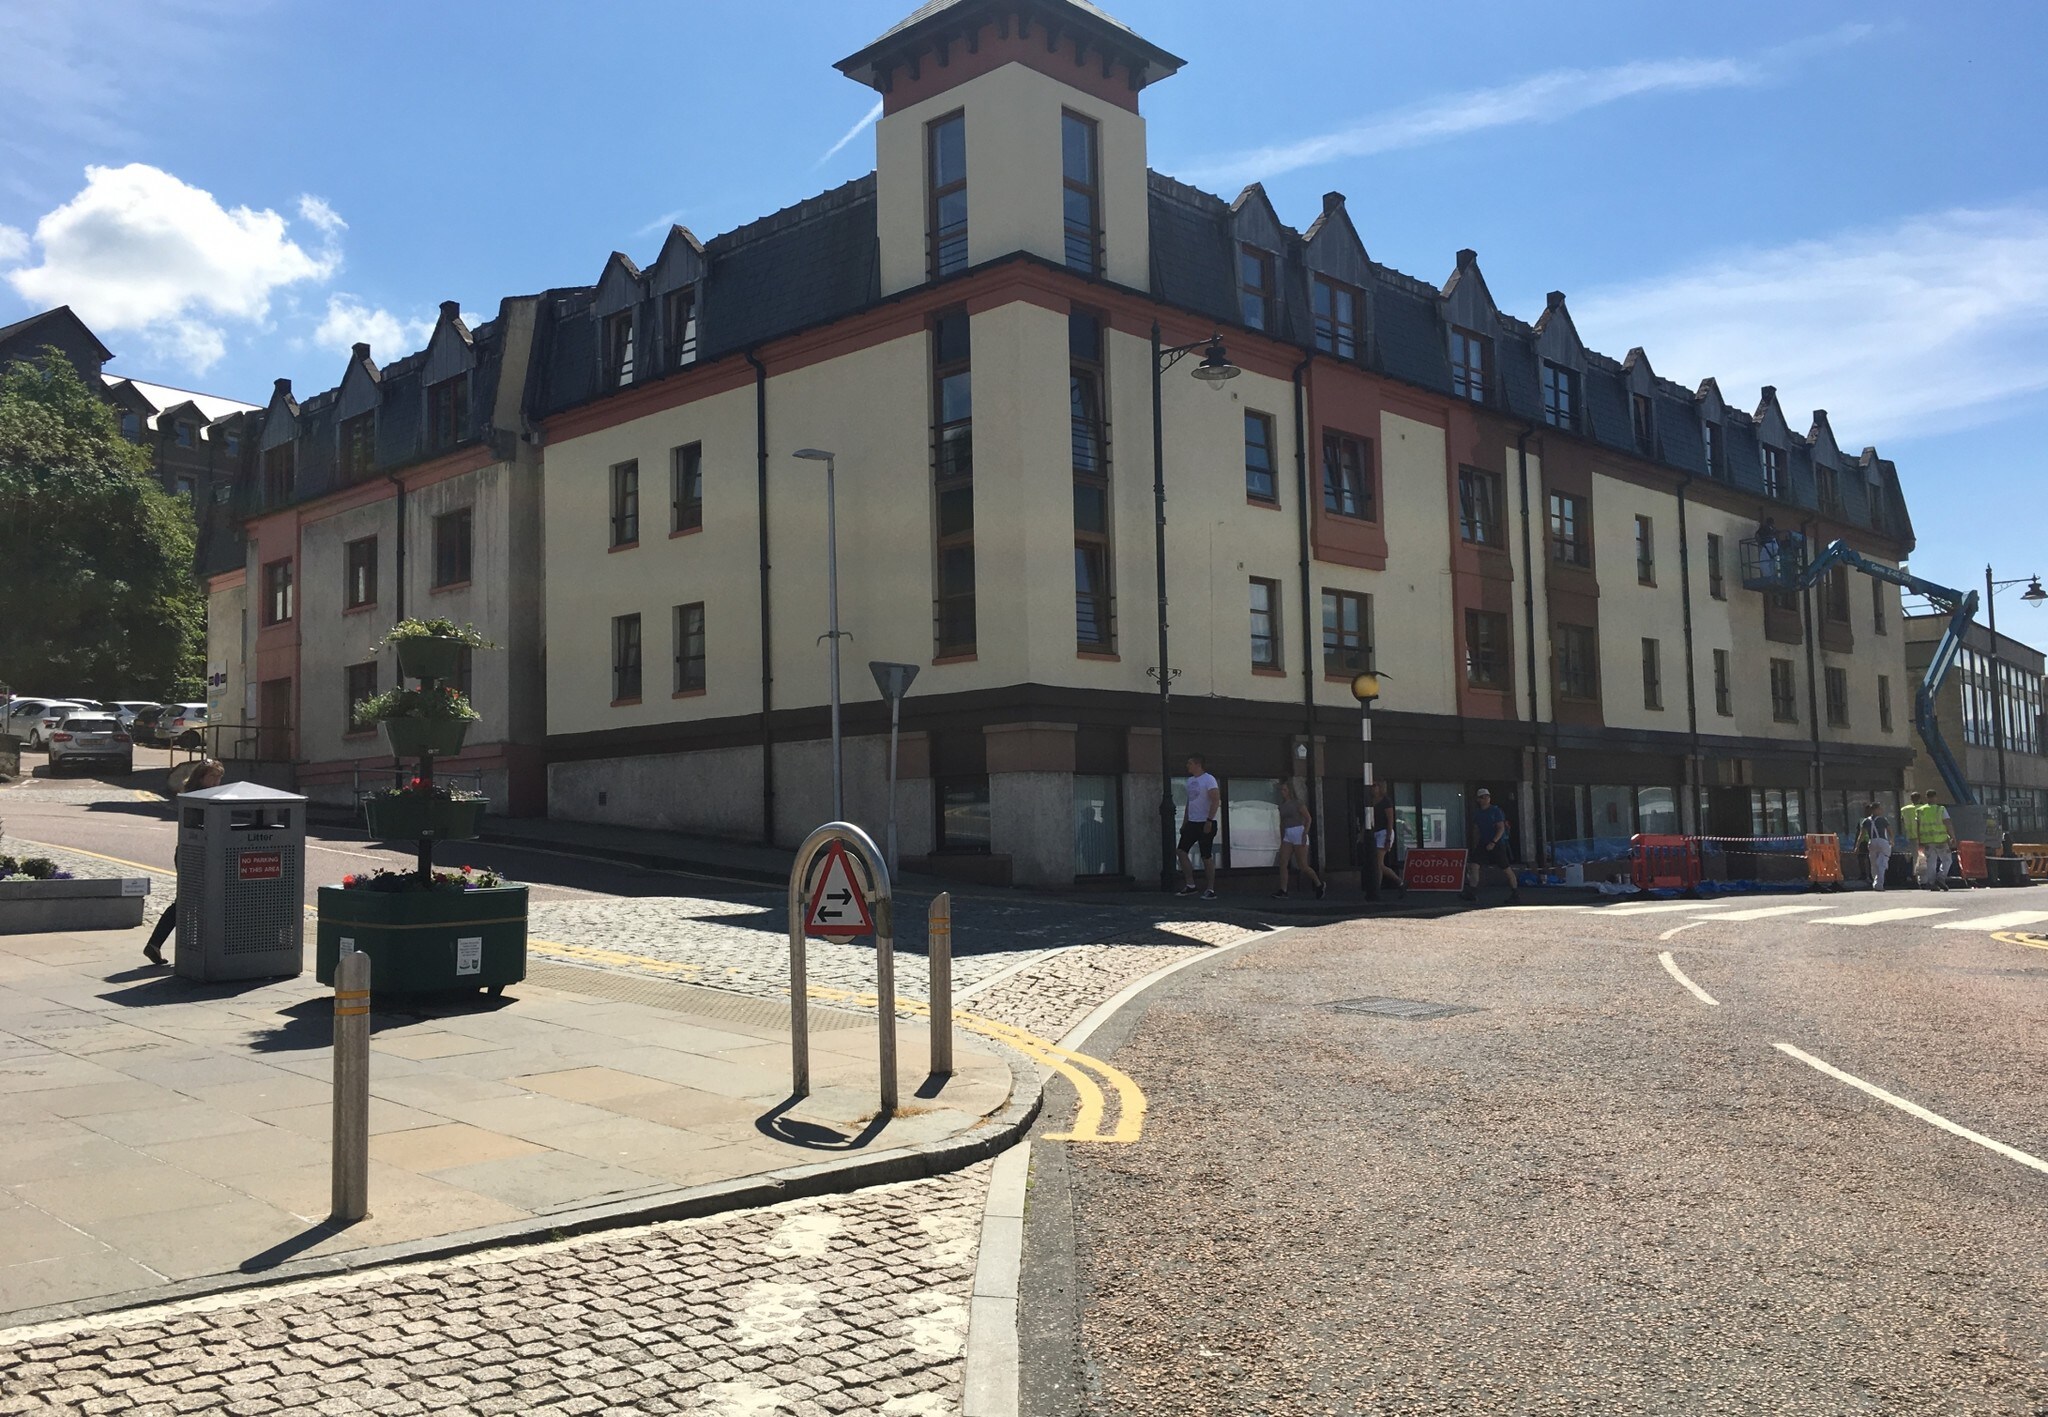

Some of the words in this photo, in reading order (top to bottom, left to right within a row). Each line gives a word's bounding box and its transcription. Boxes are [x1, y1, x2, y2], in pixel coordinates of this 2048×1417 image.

[247, 833, 273, 841] Litter
[1409, 858, 1463, 868] FOOTPATH
[1412, 874, 1455, 883] CLOSED
